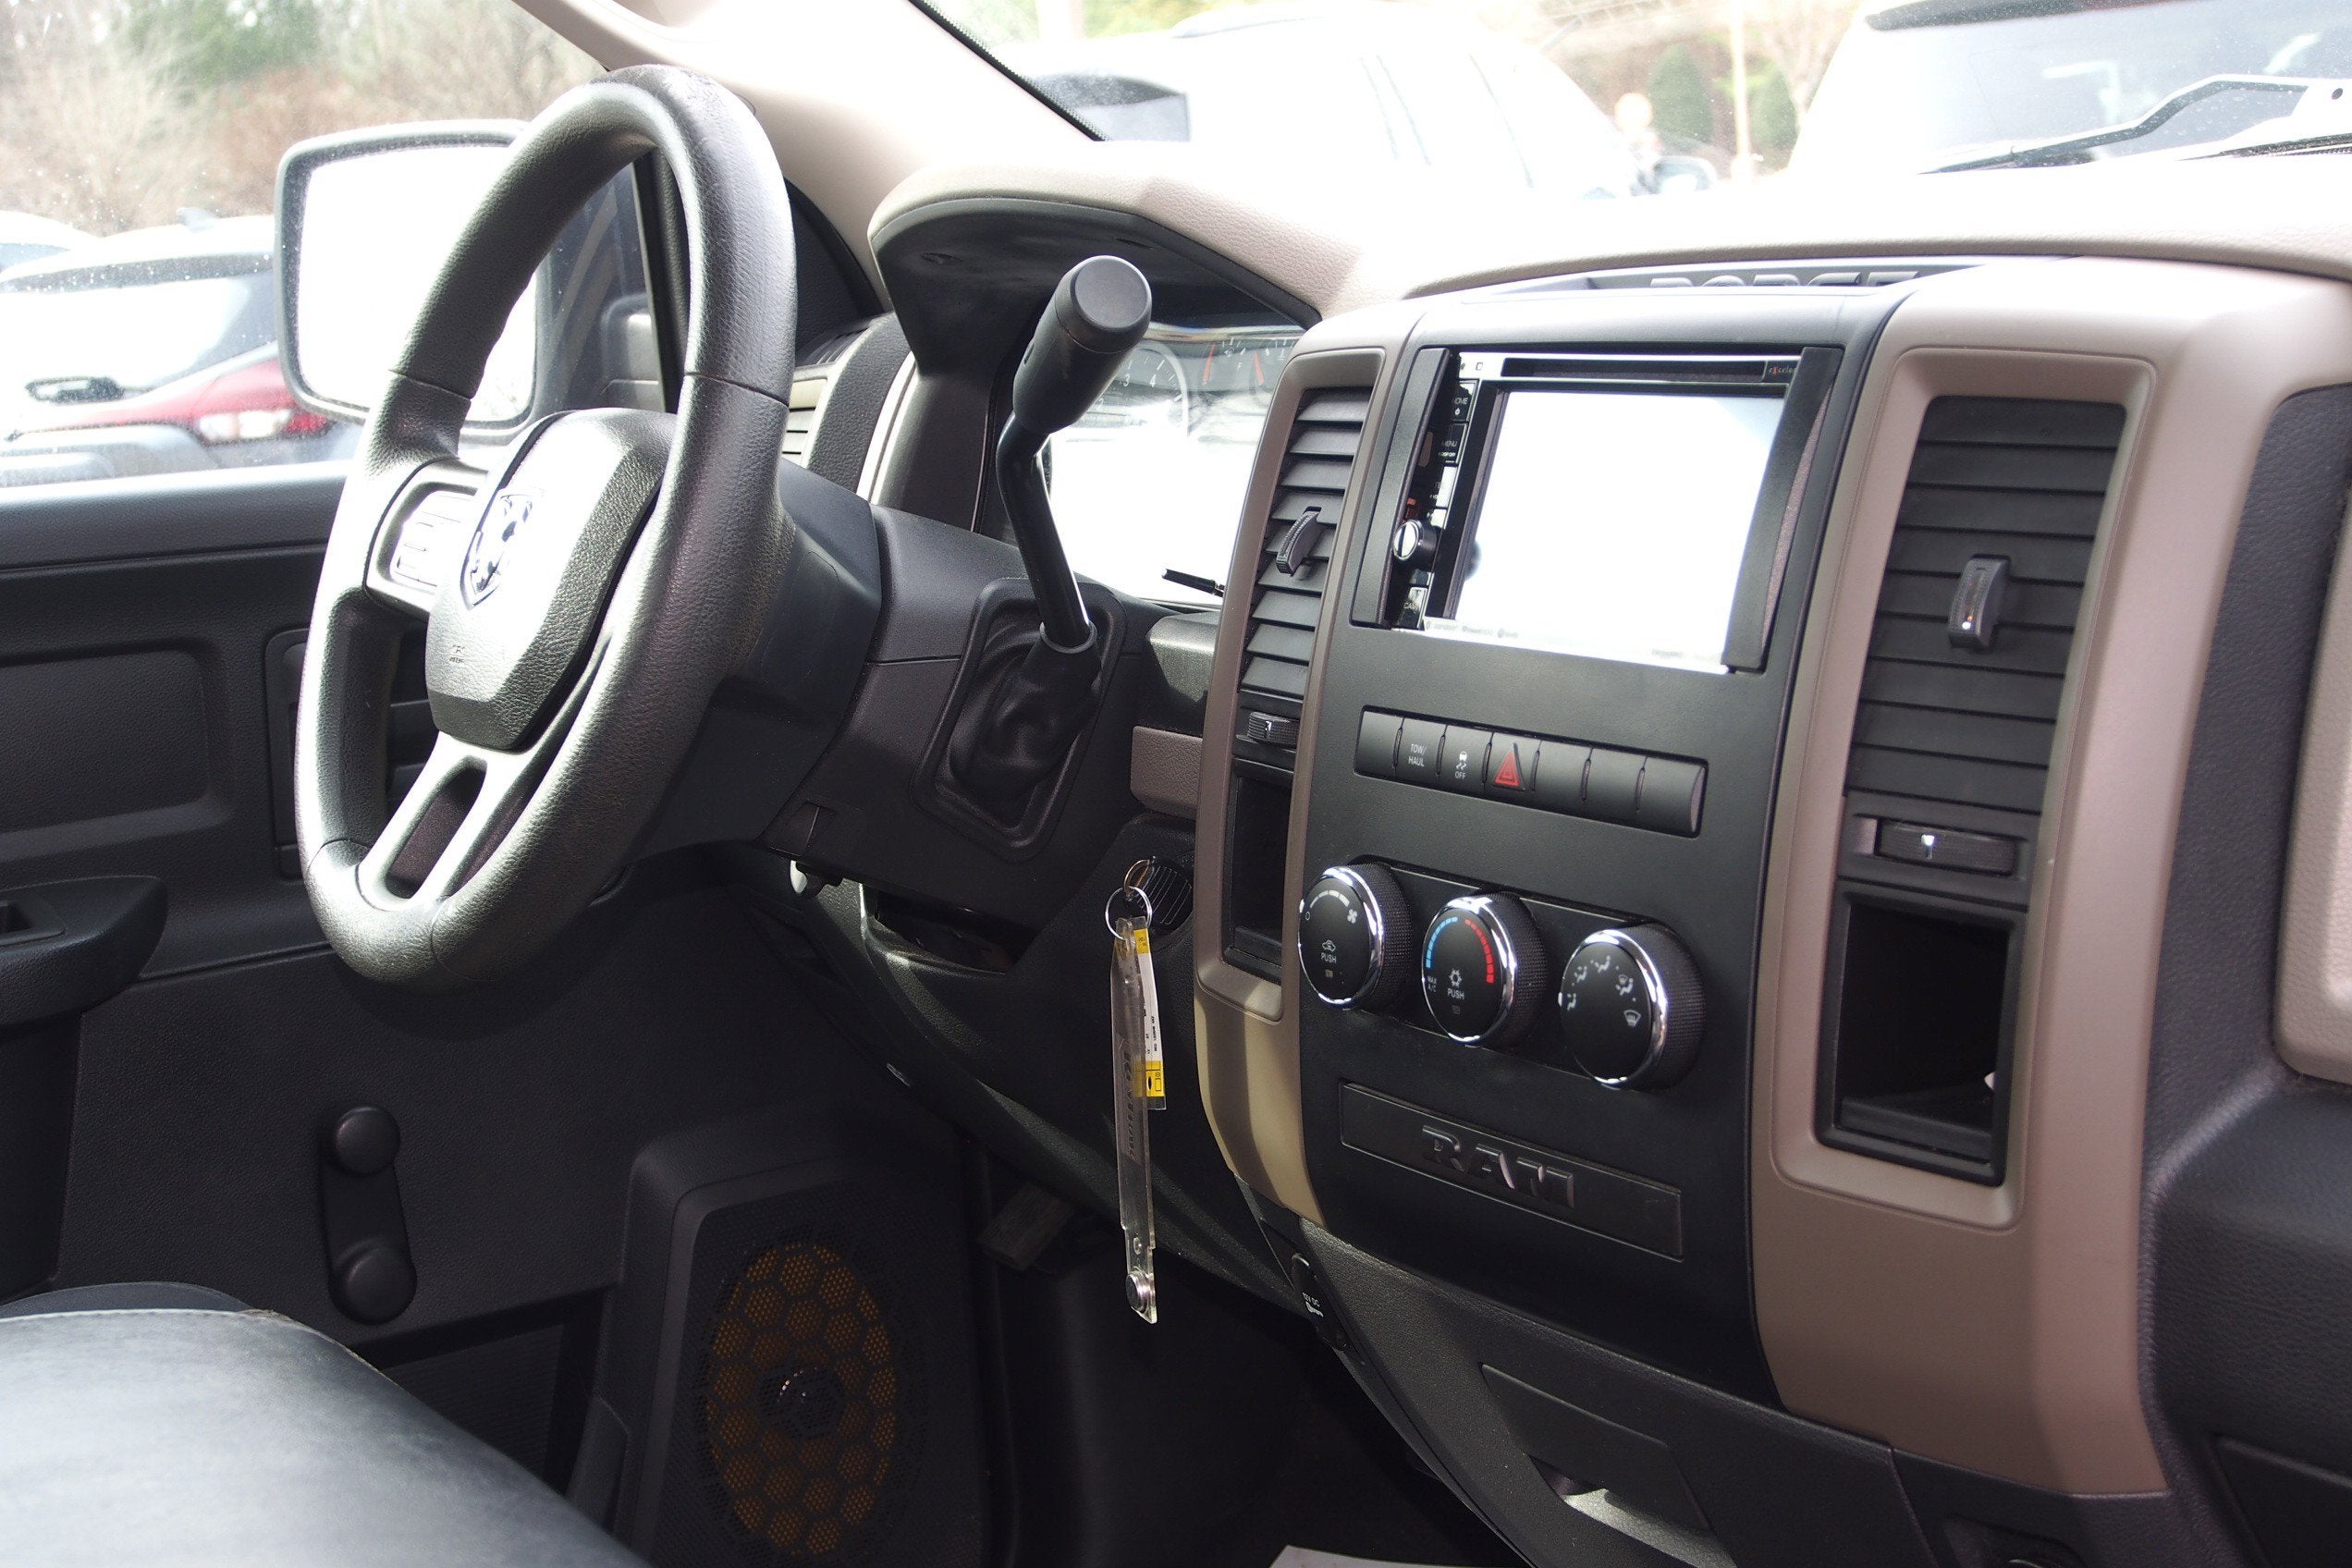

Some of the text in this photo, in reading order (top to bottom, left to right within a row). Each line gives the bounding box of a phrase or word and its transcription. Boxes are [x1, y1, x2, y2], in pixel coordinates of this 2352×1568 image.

[1149, 374, 1157, 388] 4
[1410, 743, 1427, 755] TOW/
[1408, 755, 1425, 767] HAUL
[1454, 771, 1466, 780] OFF
[1320, 952, 1337, 964] PUSH
[1447, 987, 1465, 1000] PUSH
